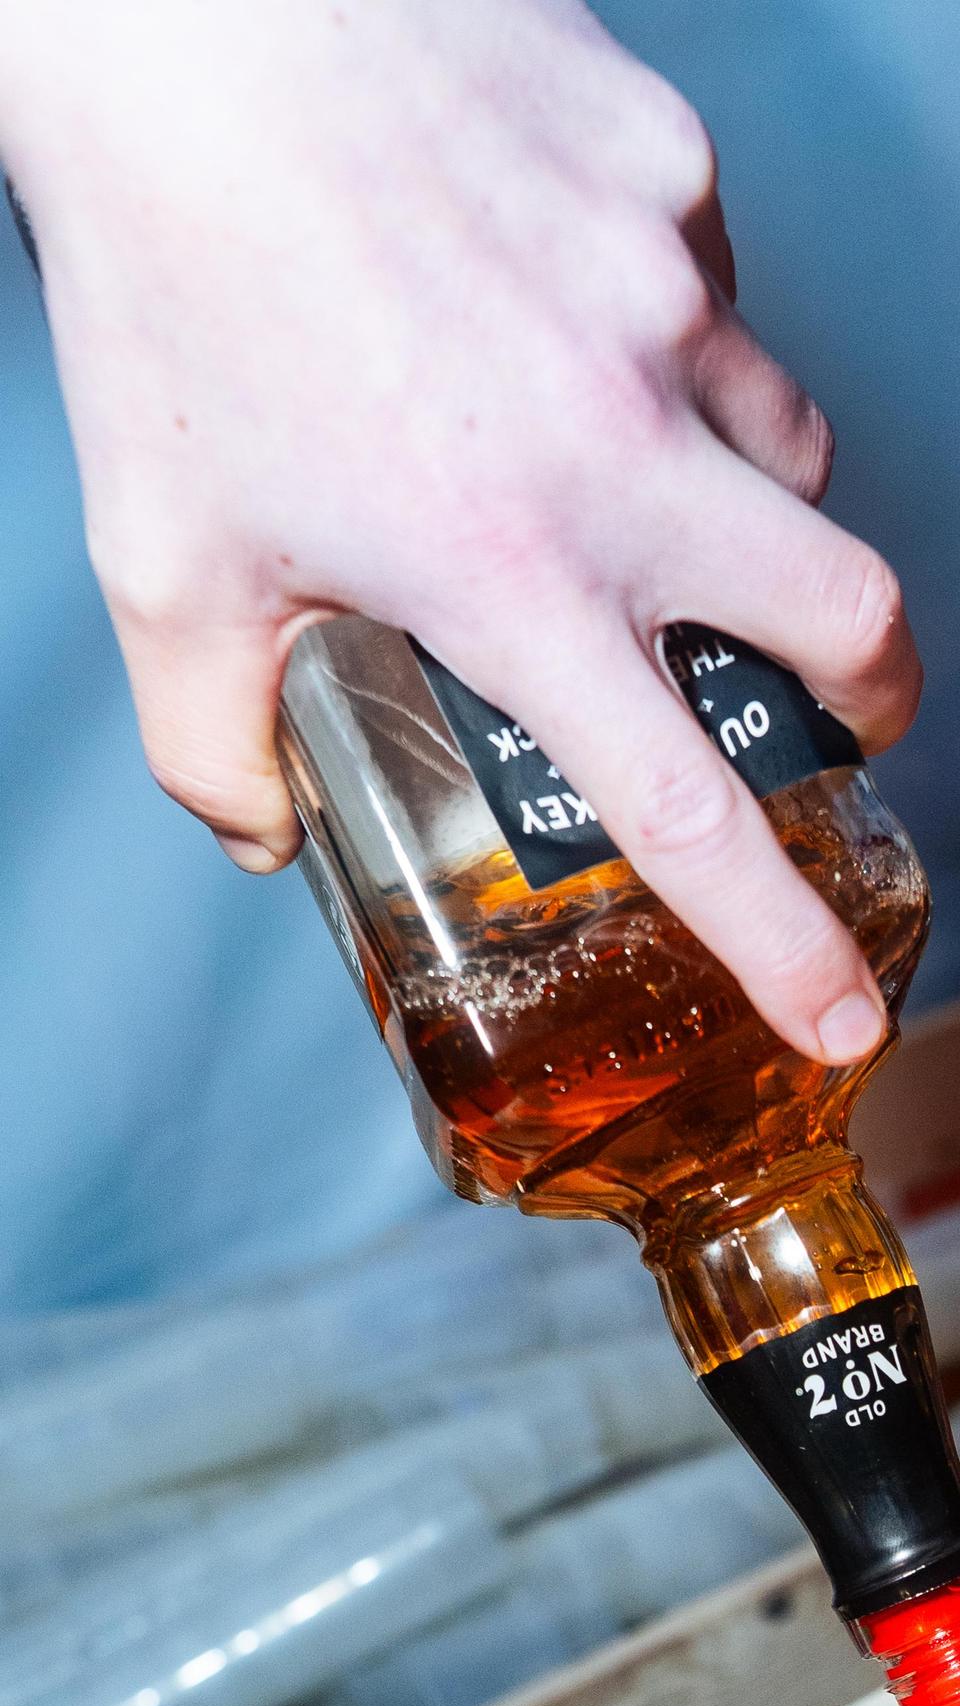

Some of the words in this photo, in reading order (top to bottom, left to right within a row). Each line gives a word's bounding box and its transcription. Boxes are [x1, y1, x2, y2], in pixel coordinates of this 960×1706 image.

[719, 700, 770, 758] OU
[519, 792, 598, 835] KEY
[802, 1324, 886, 1369] BRAND
[845, 1399, 886, 1427] OLD
